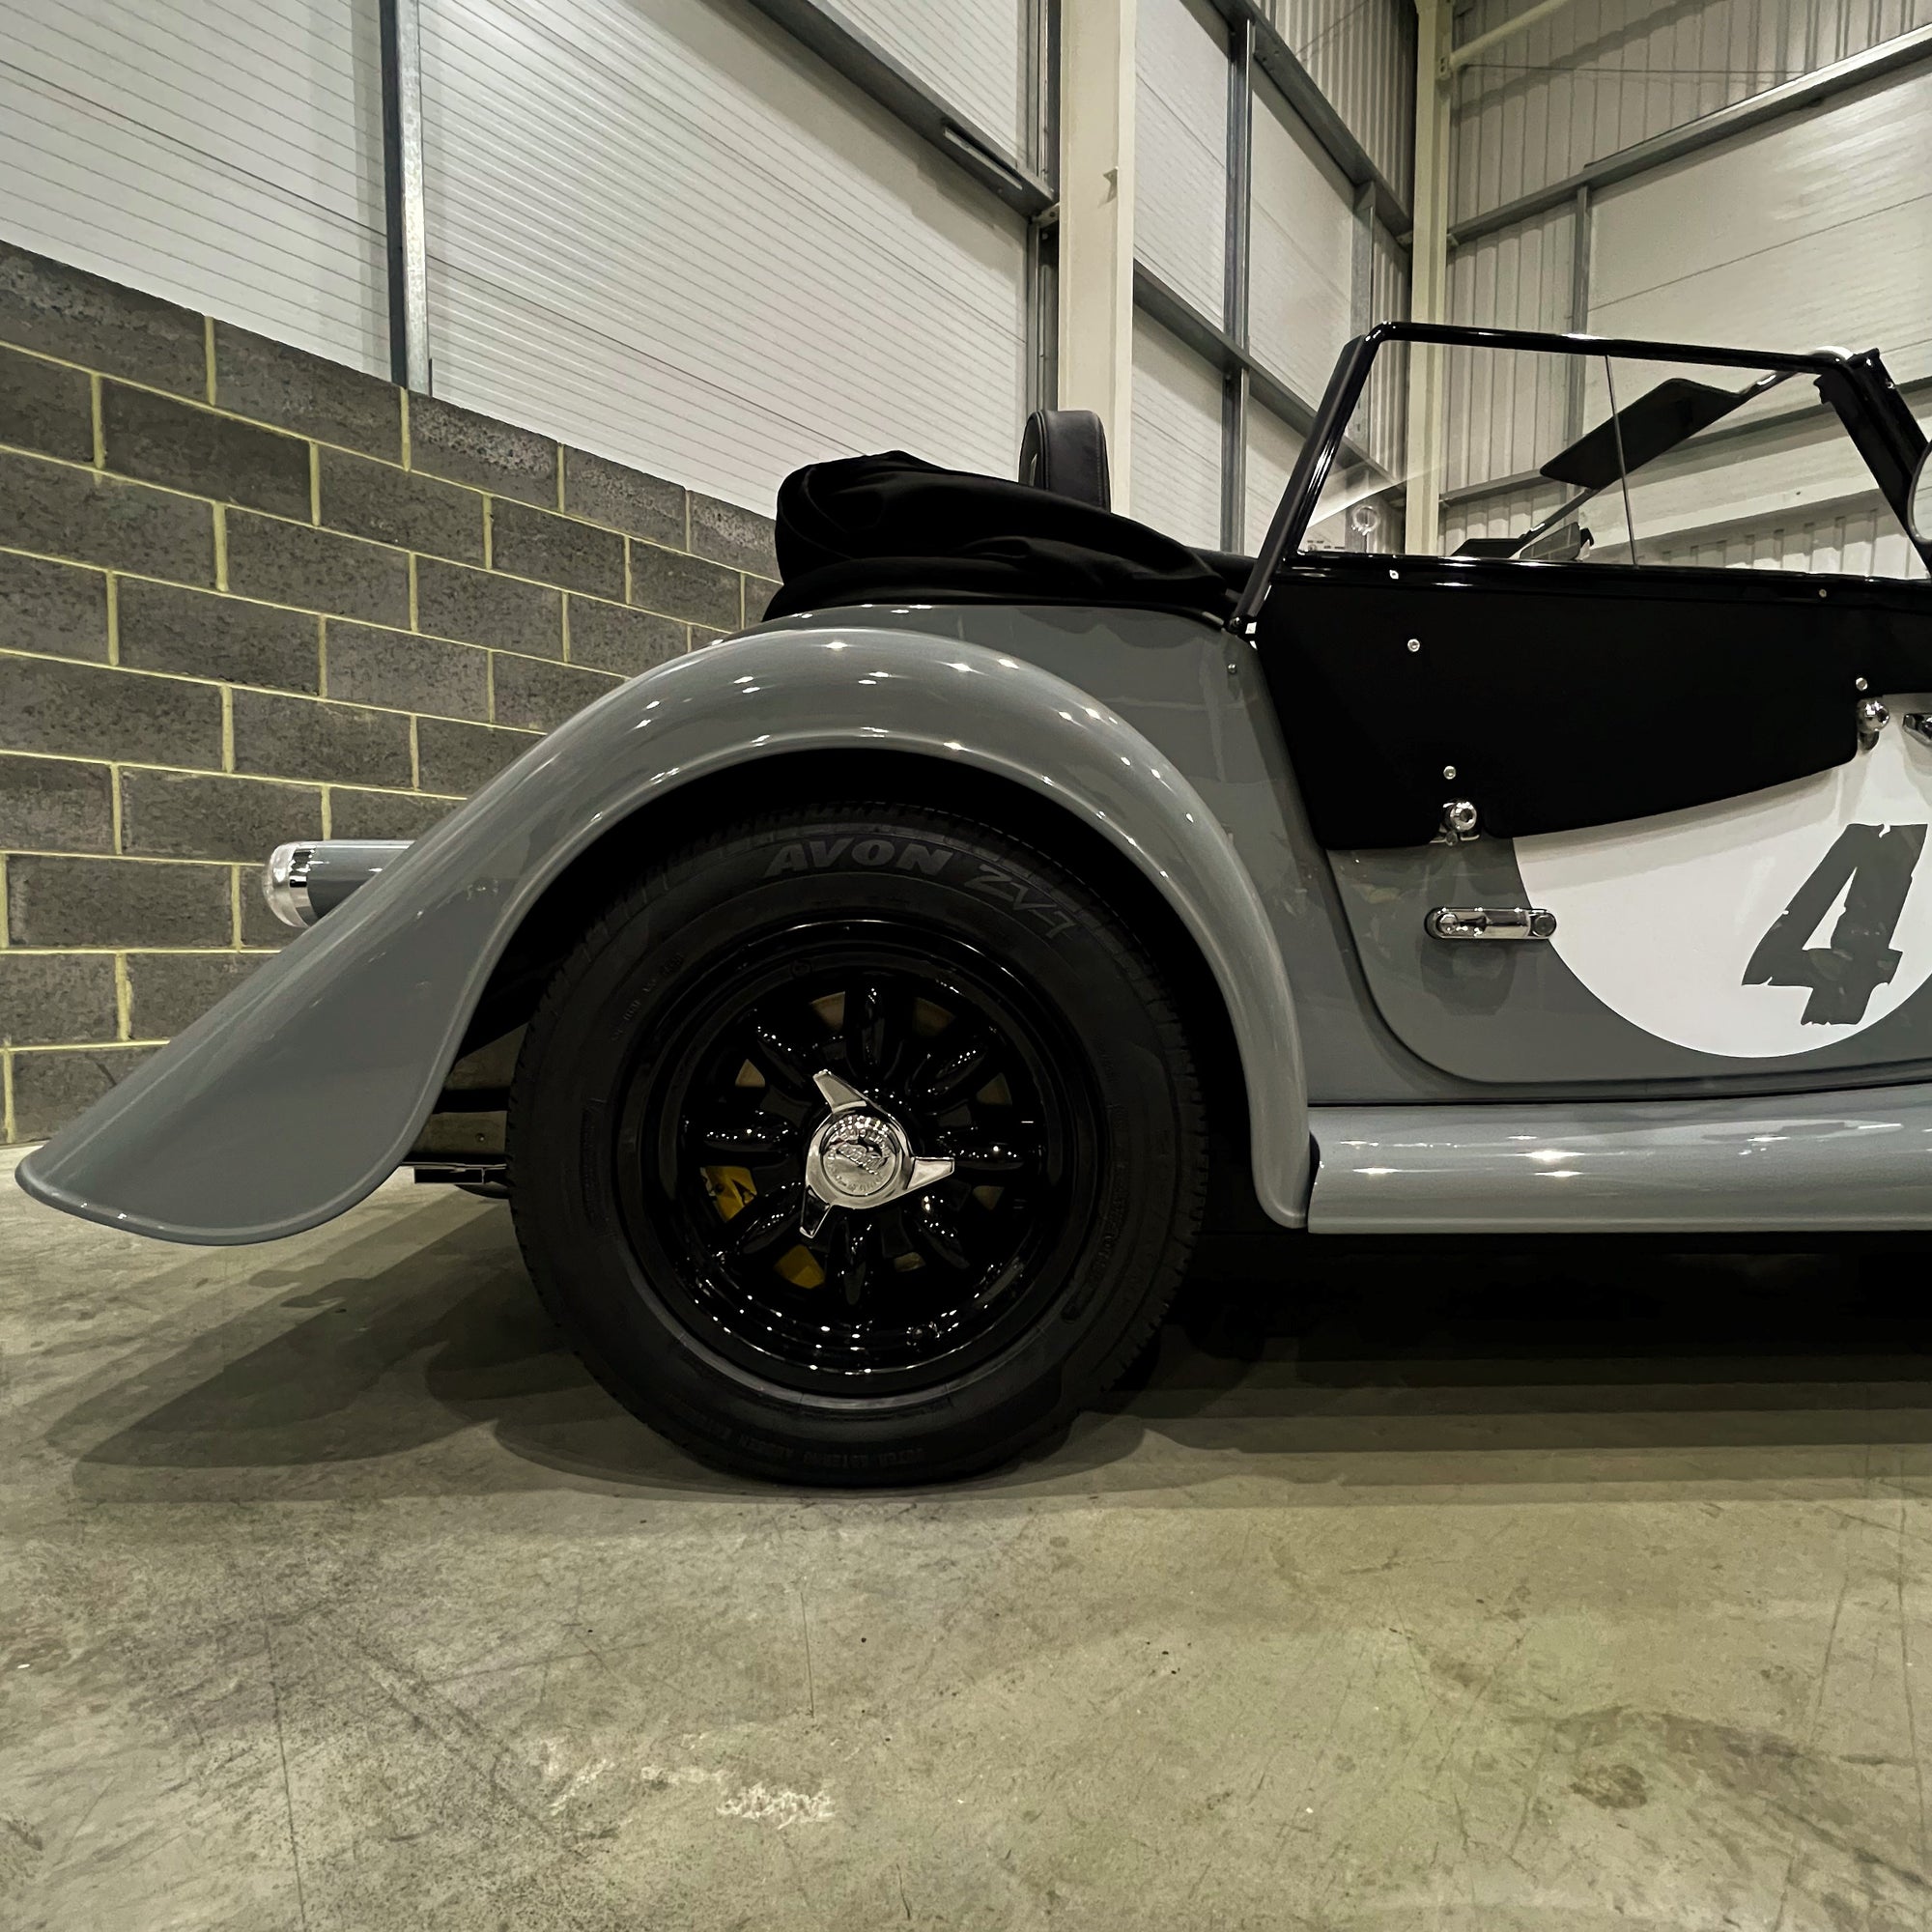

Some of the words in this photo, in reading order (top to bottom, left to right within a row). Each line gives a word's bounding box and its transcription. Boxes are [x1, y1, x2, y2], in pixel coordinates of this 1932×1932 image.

[764, 838, 953, 877] AVON
[964, 864, 1076, 940] ZV7
[1742, 823, 1928, 1025] 4
